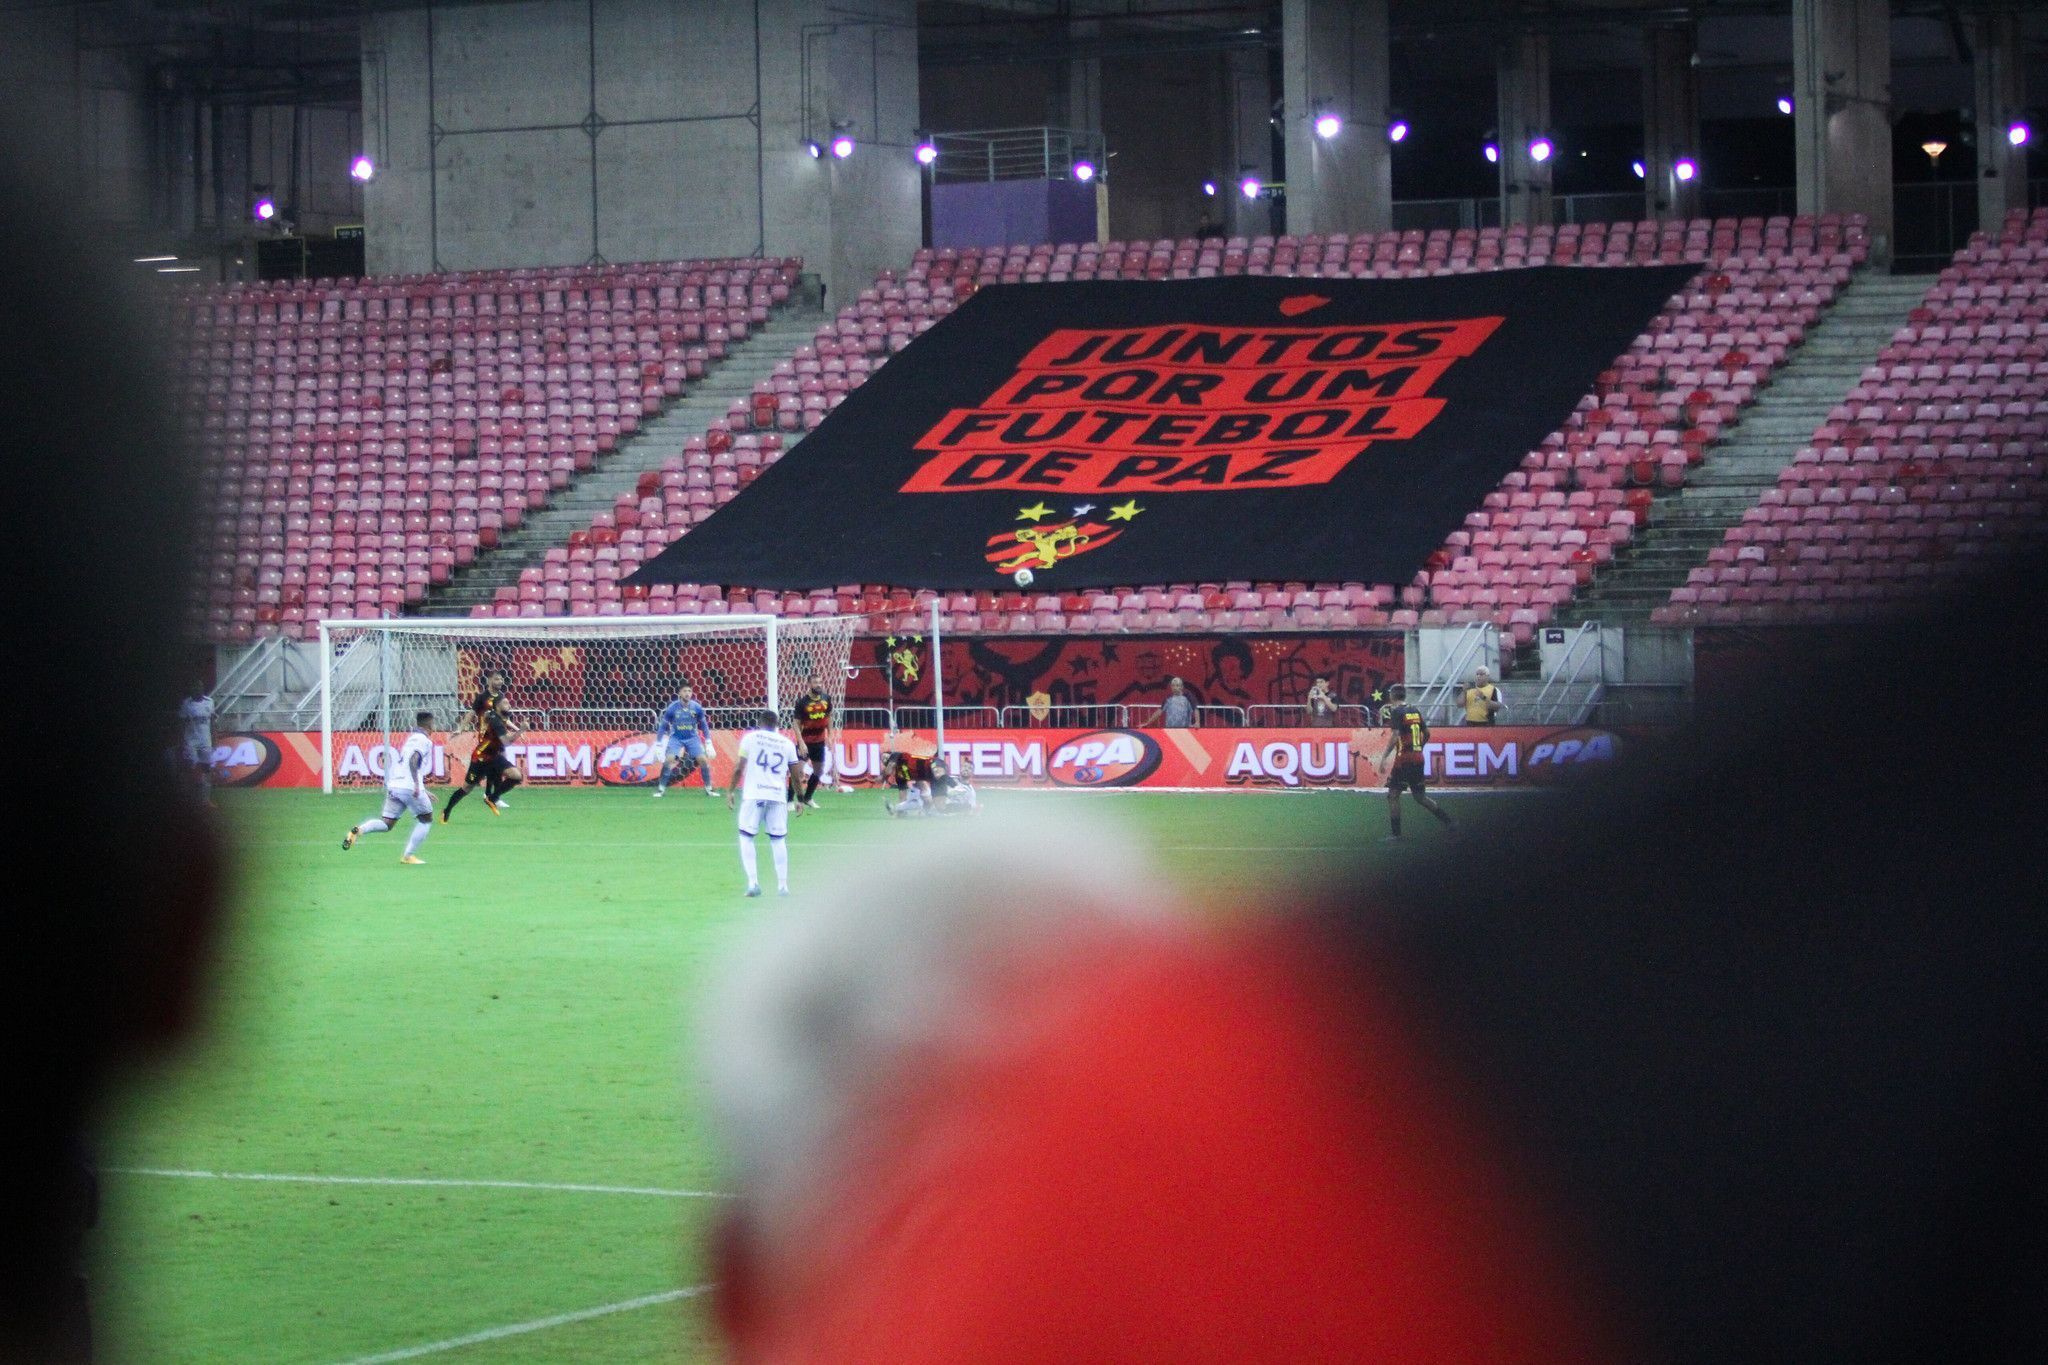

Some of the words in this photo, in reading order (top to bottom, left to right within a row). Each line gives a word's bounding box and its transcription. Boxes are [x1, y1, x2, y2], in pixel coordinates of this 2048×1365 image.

[1049, 326, 1458, 366] JUNTOS
[1006, 369, 1225, 405] POR
[1244, 365, 1422, 403] UM
[939, 405, 1397, 447] FUTEBOL
[940, 450, 1094, 487] DE
[1096, 448, 1323, 489] PAZ
[209, 741, 260, 768] PA
[339, 744, 446, 777] AI
[504, 744, 593, 777] TEM
[756, 749, 784, 774] 42
[943, 742, 1042, 776] TEM
[1053, 735, 1137, 768] PPA
[1227, 741, 1350, 785] AQUI
[1422, 741, 1518, 776] TEM
[1528, 735, 1613, 767] PPA
